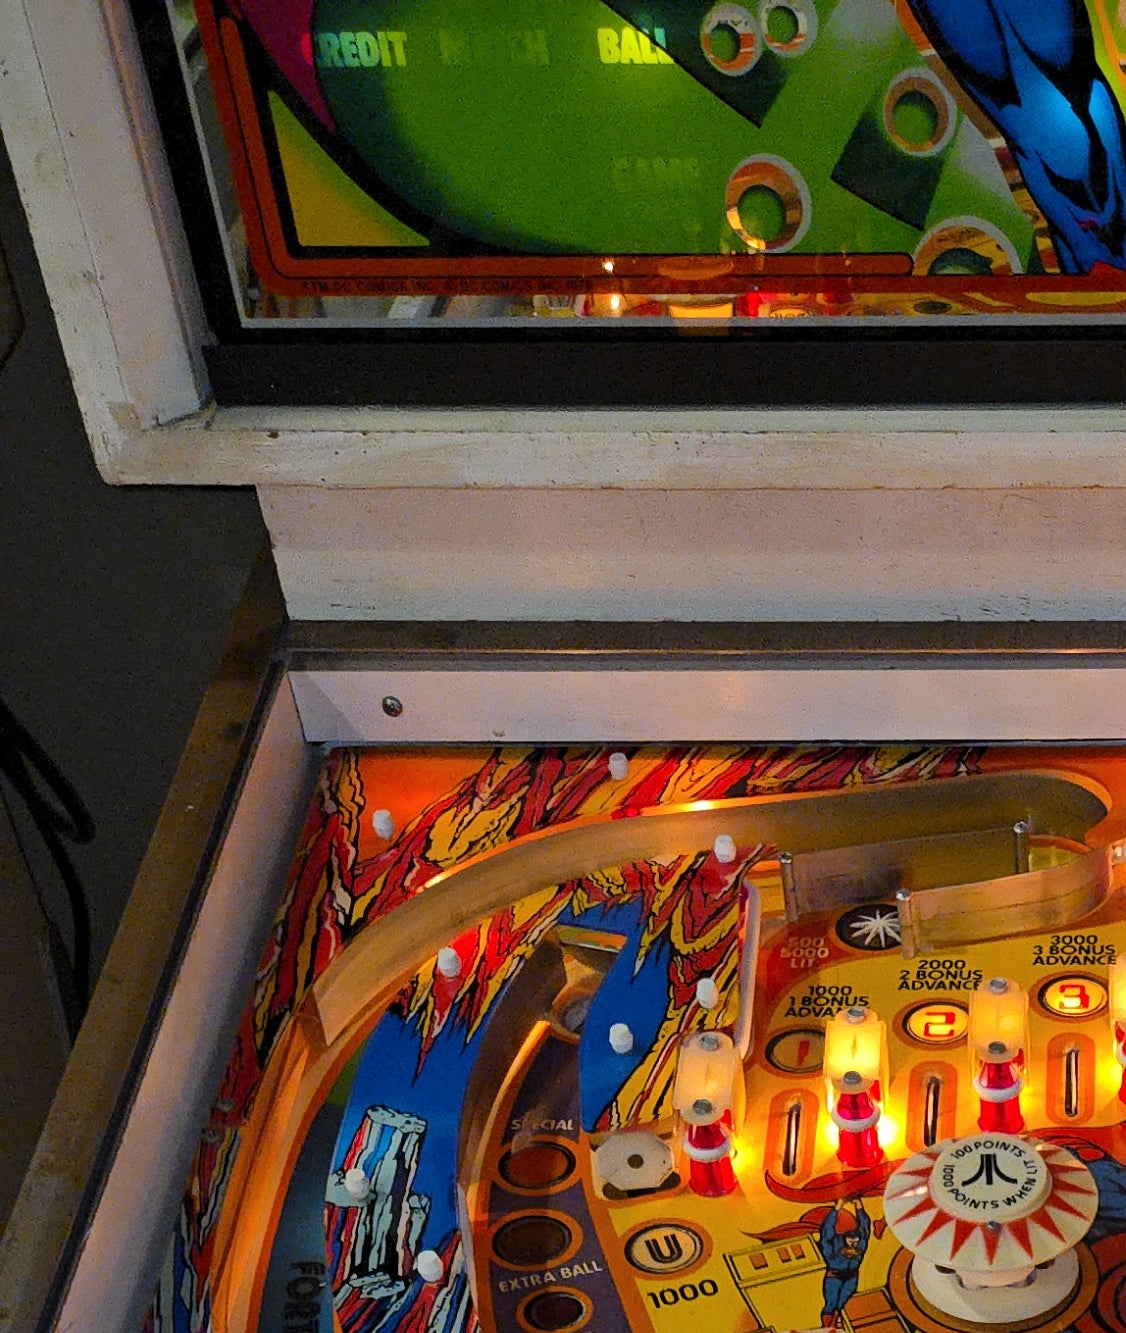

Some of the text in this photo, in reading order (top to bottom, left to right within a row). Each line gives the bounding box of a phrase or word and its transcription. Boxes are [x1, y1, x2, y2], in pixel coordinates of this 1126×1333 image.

[597, 27, 676, 65] BALL
[1050, 934, 1098, 945] 3000
[1033, 944, 1116, 955] 3 BONUS
[918, 959, 966, 970] 2000
[1033, 954, 1117, 965] ADVANCE
[900, 969, 983, 980] 2 BONUS
[808, 985, 853, 996] 1000
[897, 980, 982, 991] ADVANCE
[789, 996, 869, 1006] 1 BONUS
[1059, 984, 1090, 1009] 3
[924, 1011, 956, 1038] 2
[797, 1039, 811, 1066] 1
[510, 1117, 575, 1133] SPECIAL
[950, 1140, 1026, 1160] 100 POINTS
[942, 1160, 1037, 1210] 1000 POINTS WHEN LIT
[645, 1234, 683, 1264] U
[498, 1260, 604, 1294] EXTRA BALL
[647, 1279, 719, 1309] 1000
